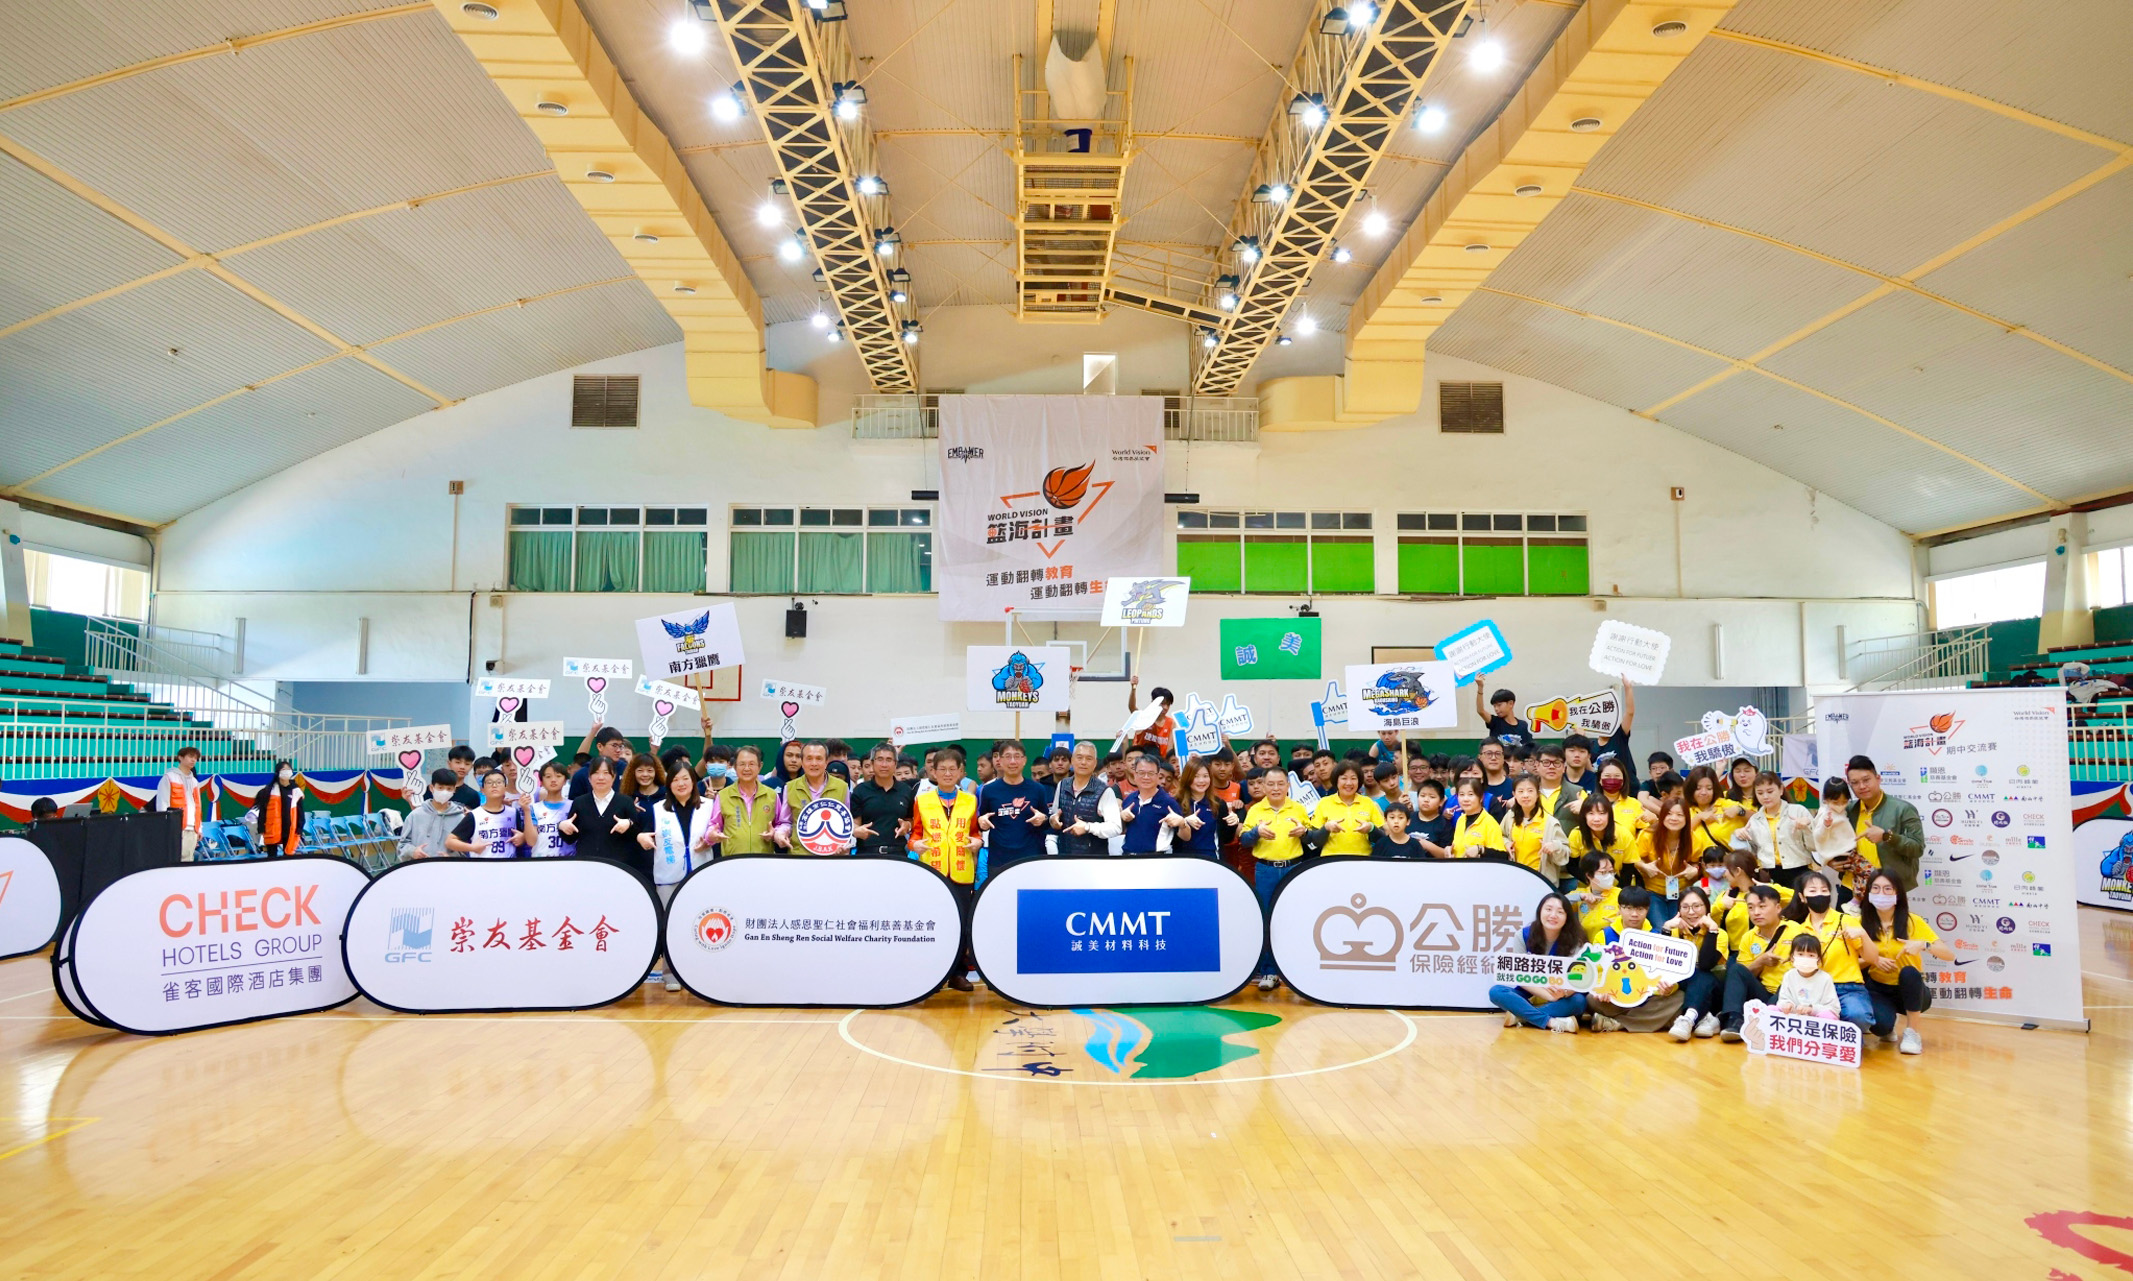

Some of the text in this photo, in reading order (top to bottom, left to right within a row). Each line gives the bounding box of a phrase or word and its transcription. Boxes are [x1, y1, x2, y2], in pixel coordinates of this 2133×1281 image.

[988, 508, 1048, 522] WORLD VISION
[986, 516, 1074, 544] 籃海計畫
[986, 565, 1074, 587] 運動翻轉教育
[1030, 580, 1109, 600] 運動翻轉生
[1235, 632, 1302, 666] 誠 美
[1606, 646, 1626, 654] ACTION
[668, 652, 720, 674] 南方獵鷹
[1604, 655, 1626, 664] ACTION
[1638, 662, 1653, 671] LOVE
[996, 690, 1040, 704] MONKEYS
[1362, 688, 1410, 700] MEGASHARK
[1322, 702, 1348, 714] CMMT
[1569, 700, 1615, 716] 我在公勝
[1220, 714, 1248, 726] CMMT
[1383, 717, 1420, 727] 海島巨浪
[390, 730, 448, 747] 崇友基金會
[508, 726, 560, 742] 崇友基金會
[1186, 731, 1216, 744] CMMT
[1676, 730, 1731, 754] 我在公勝
[1694, 743, 1735, 764] 我驕傲
[1946, 742, 1998, 755] 期中交流賽
[1296, 790, 1314, 804] MMT
[548, 836, 564, 848] 30
[1972, 898, 2001, 906] CMMT
[159, 884, 322, 938] CHECK
[744, 918, 936, 932] 財團法人感恩聖仁社會福利慈善基金會
[1065, 911, 1171, 936] CMMT
[1409, 902, 1524, 953] 公勝
[2028, 920, 2050, 928] CHECK
[450, 914, 620, 953] 崇友基金會
[744, 933, 936, 944] Gan En Sheng Ren Social Welfare Charity Foundation
[162, 934, 322, 967] HOTELS GROUP
[1070, 938, 1167, 952] 誠美材料科技
[1628, 938, 1652, 950] Action
[1664, 946, 1688, 958] Future
[384, 952, 432, 964] GFC
[1496, 954, 1564, 976] 網路投保
[1630, 948, 1654, 960] Action
[1666, 956, 1683, 966] Love
[162, 964, 322, 1002] 雀客國際酒店集團
[1496, 972, 1516, 983] 就找
[1769, 1014, 1857, 1044] 不只是保險
[1769, 1034, 1856, 1064] 我們分享愛
